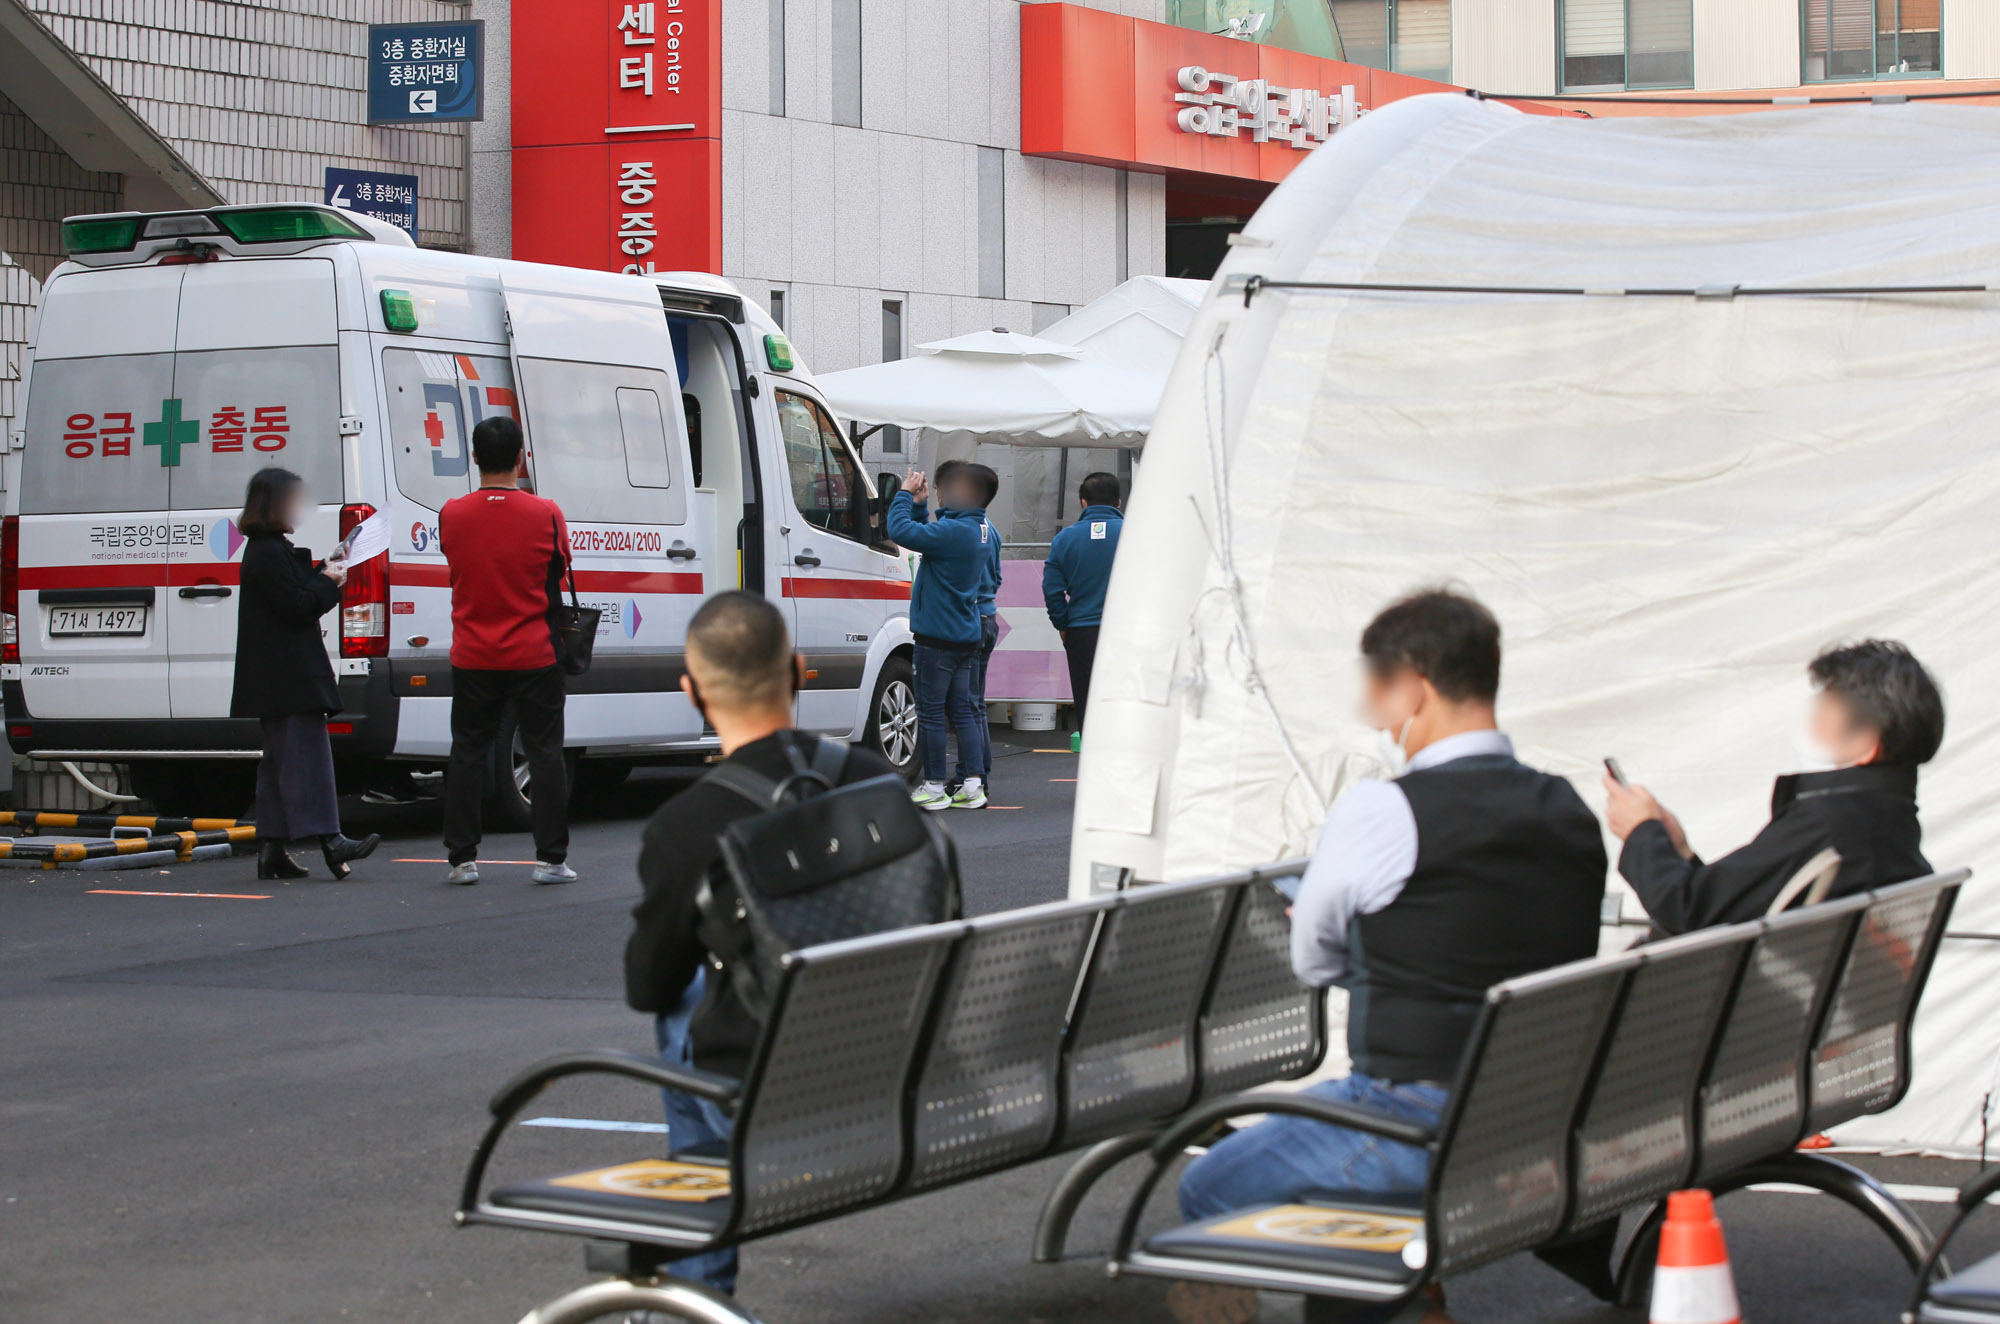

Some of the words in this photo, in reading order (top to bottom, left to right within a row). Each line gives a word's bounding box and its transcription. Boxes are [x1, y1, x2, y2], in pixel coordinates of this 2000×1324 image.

[382, 39, 405, 60] 3층
[410, 36, 466, 59] 중환자실
[617, 2, 655, 96] 센터
[667, 21, 683, 94] Center
[388, 63, 458, 86] 중환자면회
[356, 182, 372, 201] 3층
[375, 184, 413, 204] 중환자실
[63, 412, 135, 459] 응급
[208, 405, 290, 453] 출동
[90, 524, 204, 547] 국립중앙의료원
[91, 552, 124, 560] national
[125, 550, 159, 559] medical
[161, 550, 188, 558] center
[60, 611, 89, 629] 71서
[97, 610, 136, 629] 1497
[30, 666, 70, 676] AUTECH
